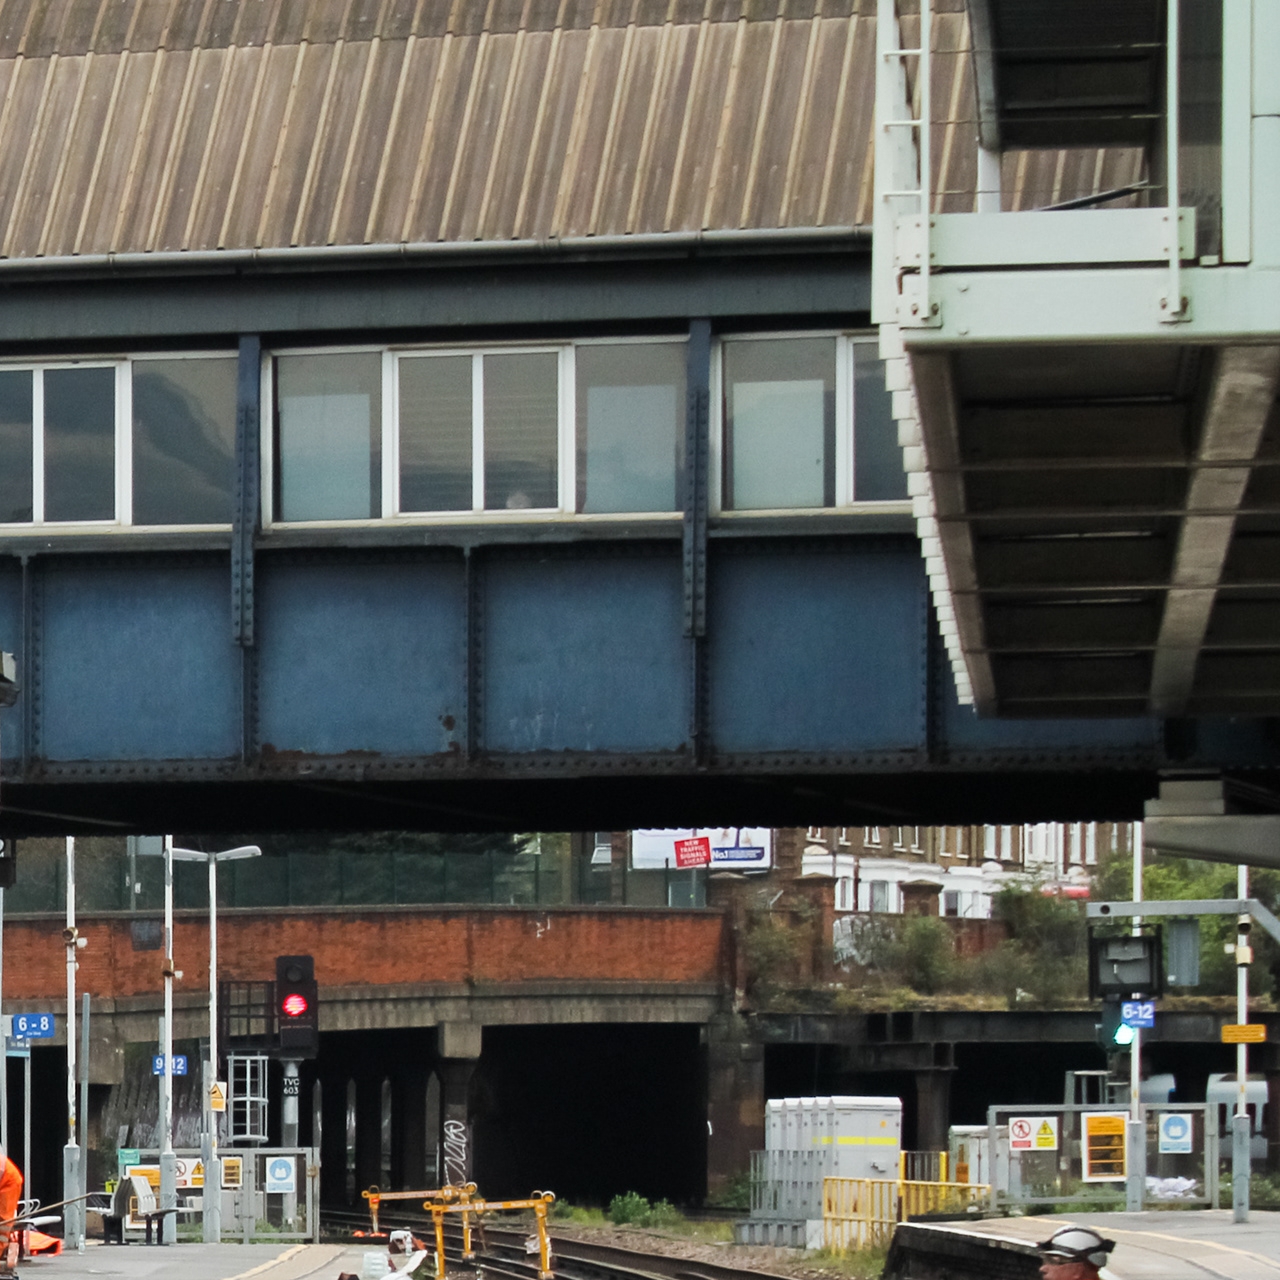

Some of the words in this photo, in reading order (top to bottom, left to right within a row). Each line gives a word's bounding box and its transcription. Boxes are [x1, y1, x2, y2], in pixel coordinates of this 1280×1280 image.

[680, 845, 705, 853] TRAFFIC
[681, 851, 707, 860] SIGNALS
[684, 857, 705, 865] AHEAD
[1123, 1003, 1154, 1019] 6-12
[19, 1017, 27, 1031] 6
[40, 1016, 49, 1031] 8
[155, 1057, 184, 1070] 912
[283, 1078, 300, 1086] TVC
[283, 1087, 299, 1095] 603
